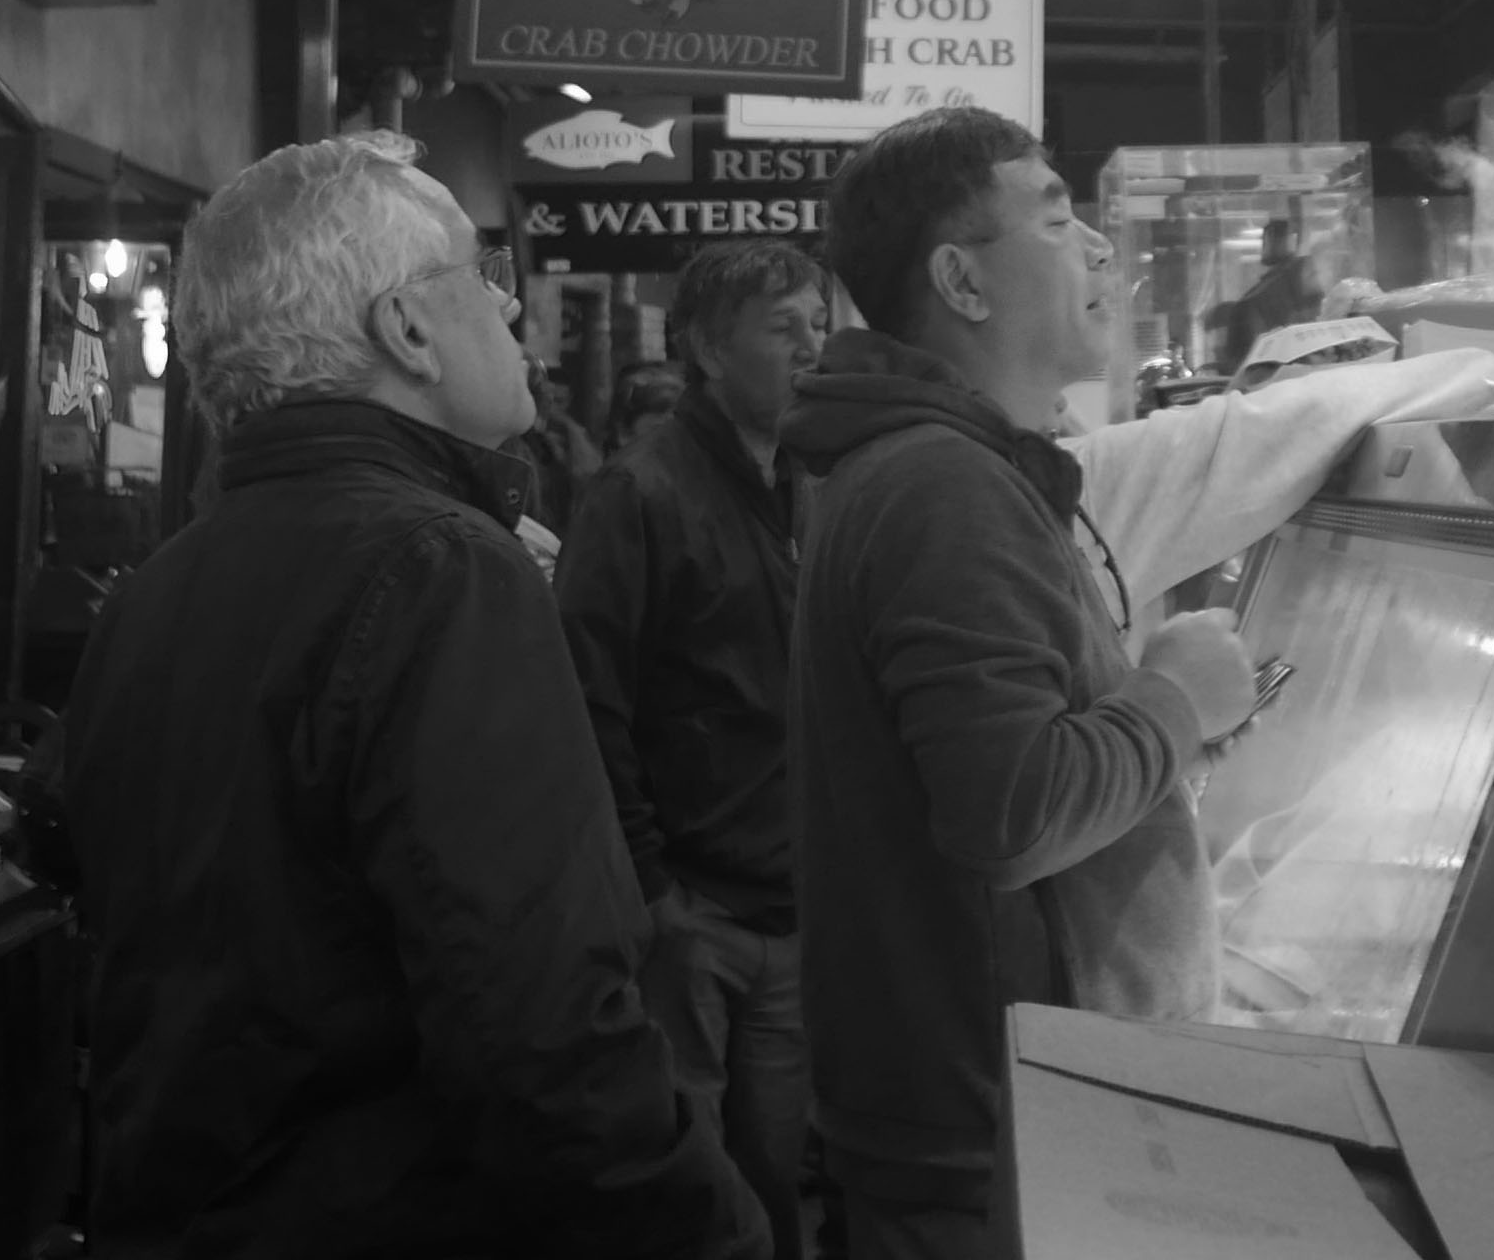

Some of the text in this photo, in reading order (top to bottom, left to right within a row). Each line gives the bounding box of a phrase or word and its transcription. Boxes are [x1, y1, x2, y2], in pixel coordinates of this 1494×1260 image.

[500, 24, 820, 68] CRAB CHOWDER
[908, 38, 1015, 66] CRAB
[541, 130, 653, 151] ALIOTO'S
[525, 199, 824, 236] & WATERSI
